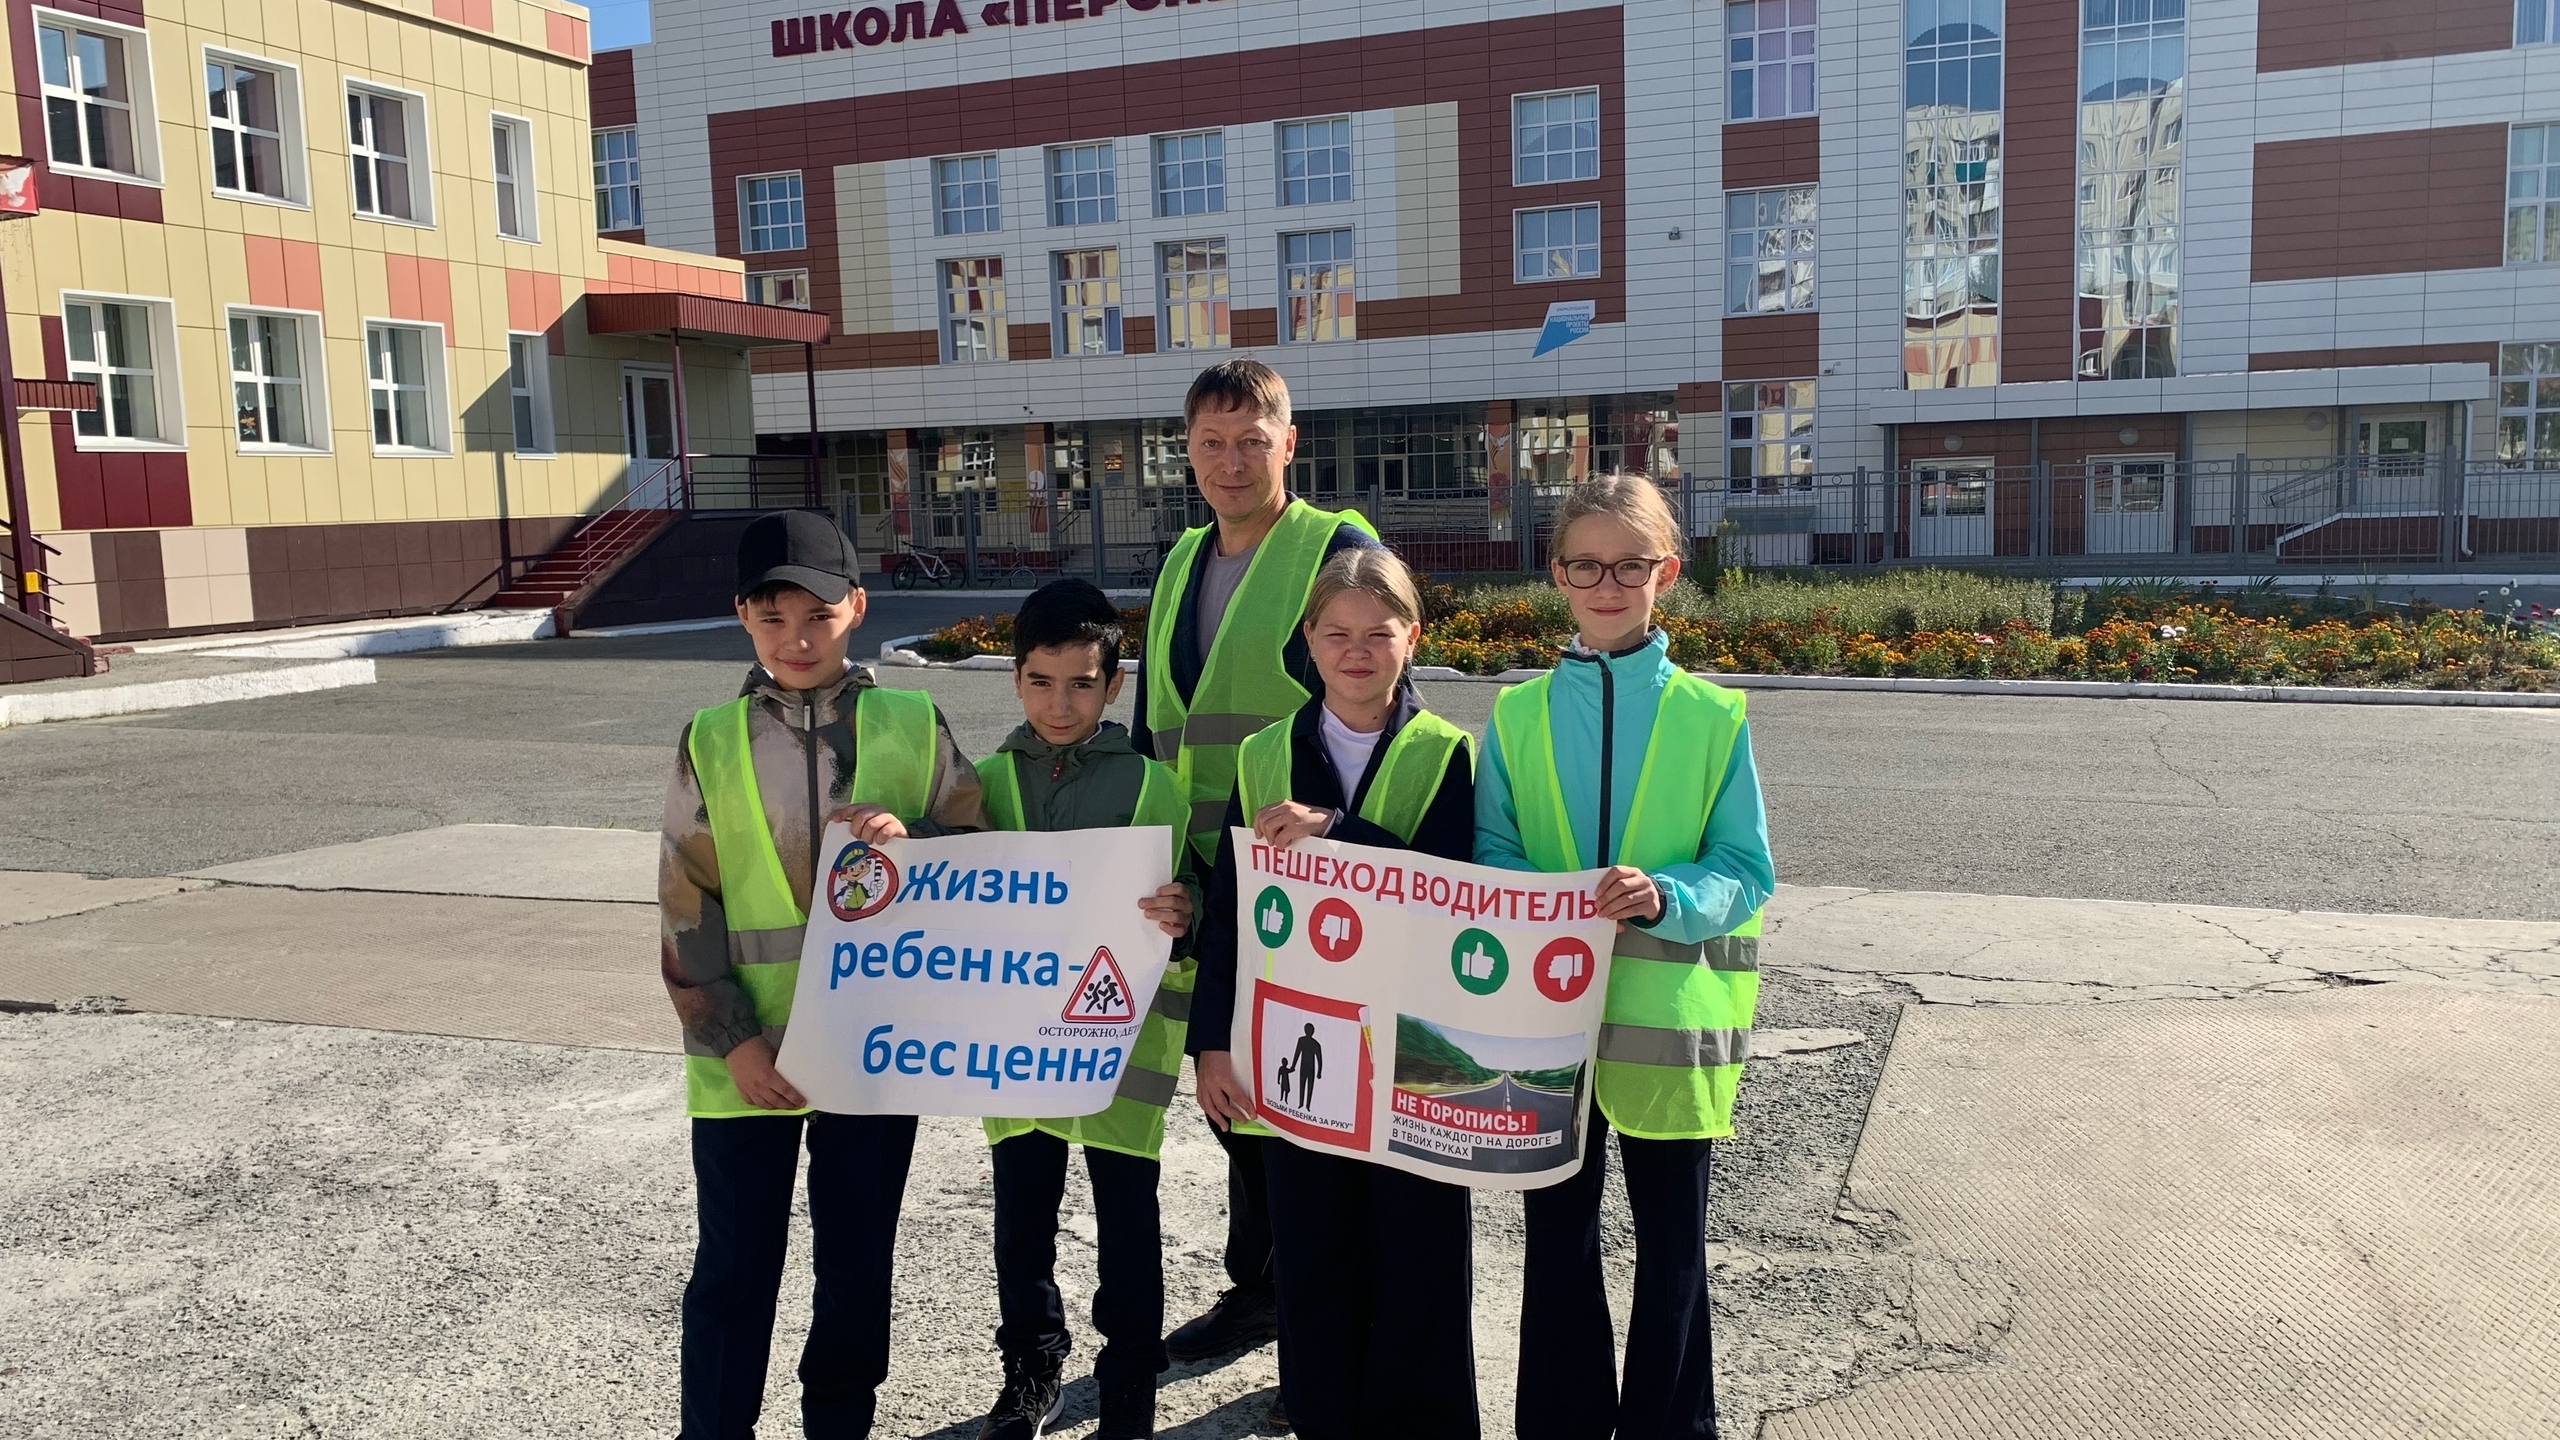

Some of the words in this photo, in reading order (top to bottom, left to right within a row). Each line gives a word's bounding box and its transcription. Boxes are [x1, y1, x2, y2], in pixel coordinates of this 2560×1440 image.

[771, 0, 968, 57] ШКОЛА
[895, 860, 1068, 905] Жизнь
[1251, 844, 1405, 904] ПЕШЕХОД
[1412, 872, 1598, 922] ВОДИТЕЛЬ
[1038, 1026, 1118, 1039] ОСТОРОЖНО,
[862, 1024, 1122, 1090] бесценна
[1288, 1108, 1318, 1123] РЕБЕНКА
[1319, 1117, 1329, 1126] ЗА
[1392, 1114, 1427, 1133] ЖИЗНЬ
[1429, 1126, 1482, 1145] КАЖДОГО
[1486, 1136, 1502, 1147] НА
[1506, 1136, 1552, 1149] ДОРОГЕ
[1396, 1092, 1417, 1114] НЕ
[1421, 1099, 1527, 1132] ТОРОПИСЬ!
[1392, 1128, 1399, 1138] В
[1402, 1131, 1432, 1149] ТВОИХ
[1435, 1140, 1469, 1157] РУКАХ
